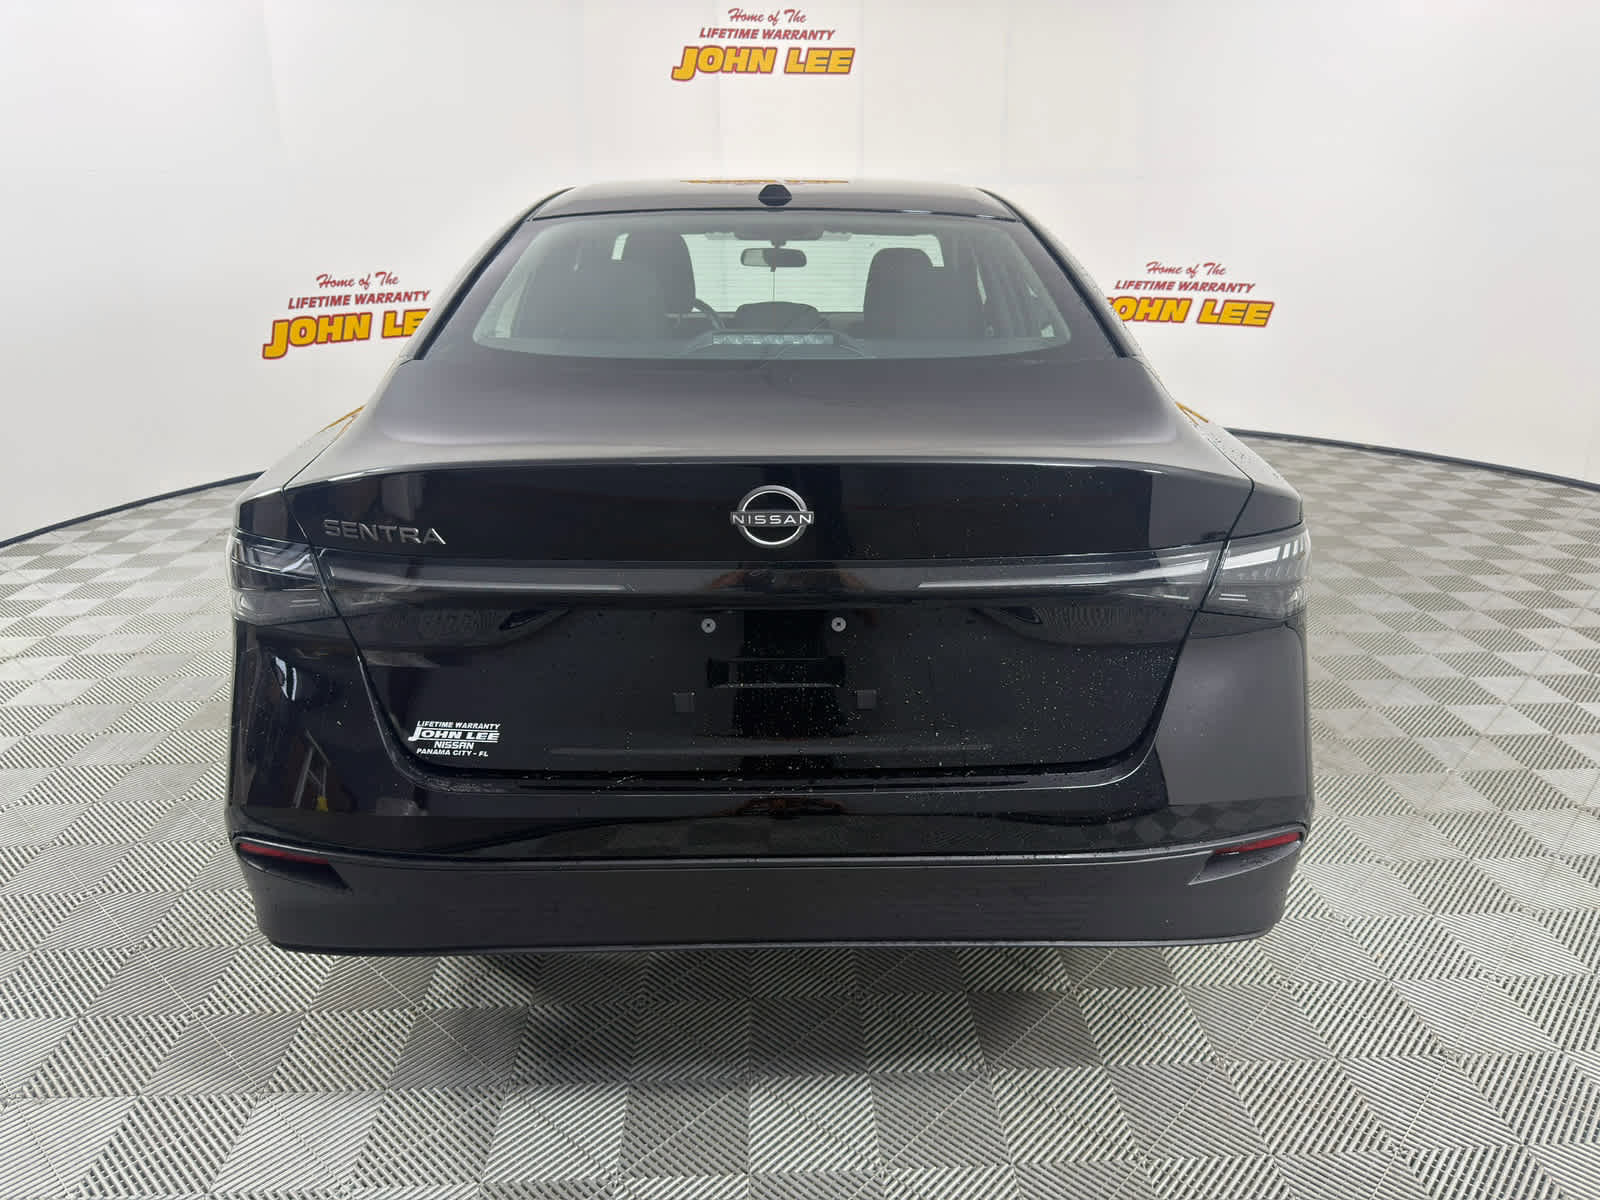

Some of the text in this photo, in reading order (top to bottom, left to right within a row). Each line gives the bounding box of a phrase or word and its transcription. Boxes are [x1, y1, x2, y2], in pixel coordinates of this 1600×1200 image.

[728, 8, 806, 25] Home of The
[700, 28, 835, 40] LIFETIME WARRANTY
[671, 45, 855, 82] JOHN LEE
[1146, 261, 1226, 278] Home of The
[316, 271, 399, 290] Home of The
[1114, 280, 1256, 293] LIFETIME WARRANTY
[288, 290, 431, 309] LIFETIME WARRANTY
[1107, 296, 1274, 328] OHN LEE
[262, 308, 431, 359] JOHN LE
[732, 514, 812, 525] NISSAN
[323, 519, 446, 544] SENTRA
[416, 720, 500, 730] LIFETIME WARRANTY
[408, 727, 500, 741] JOHN LEE
[434, 741, 475, 750] NISSAN
